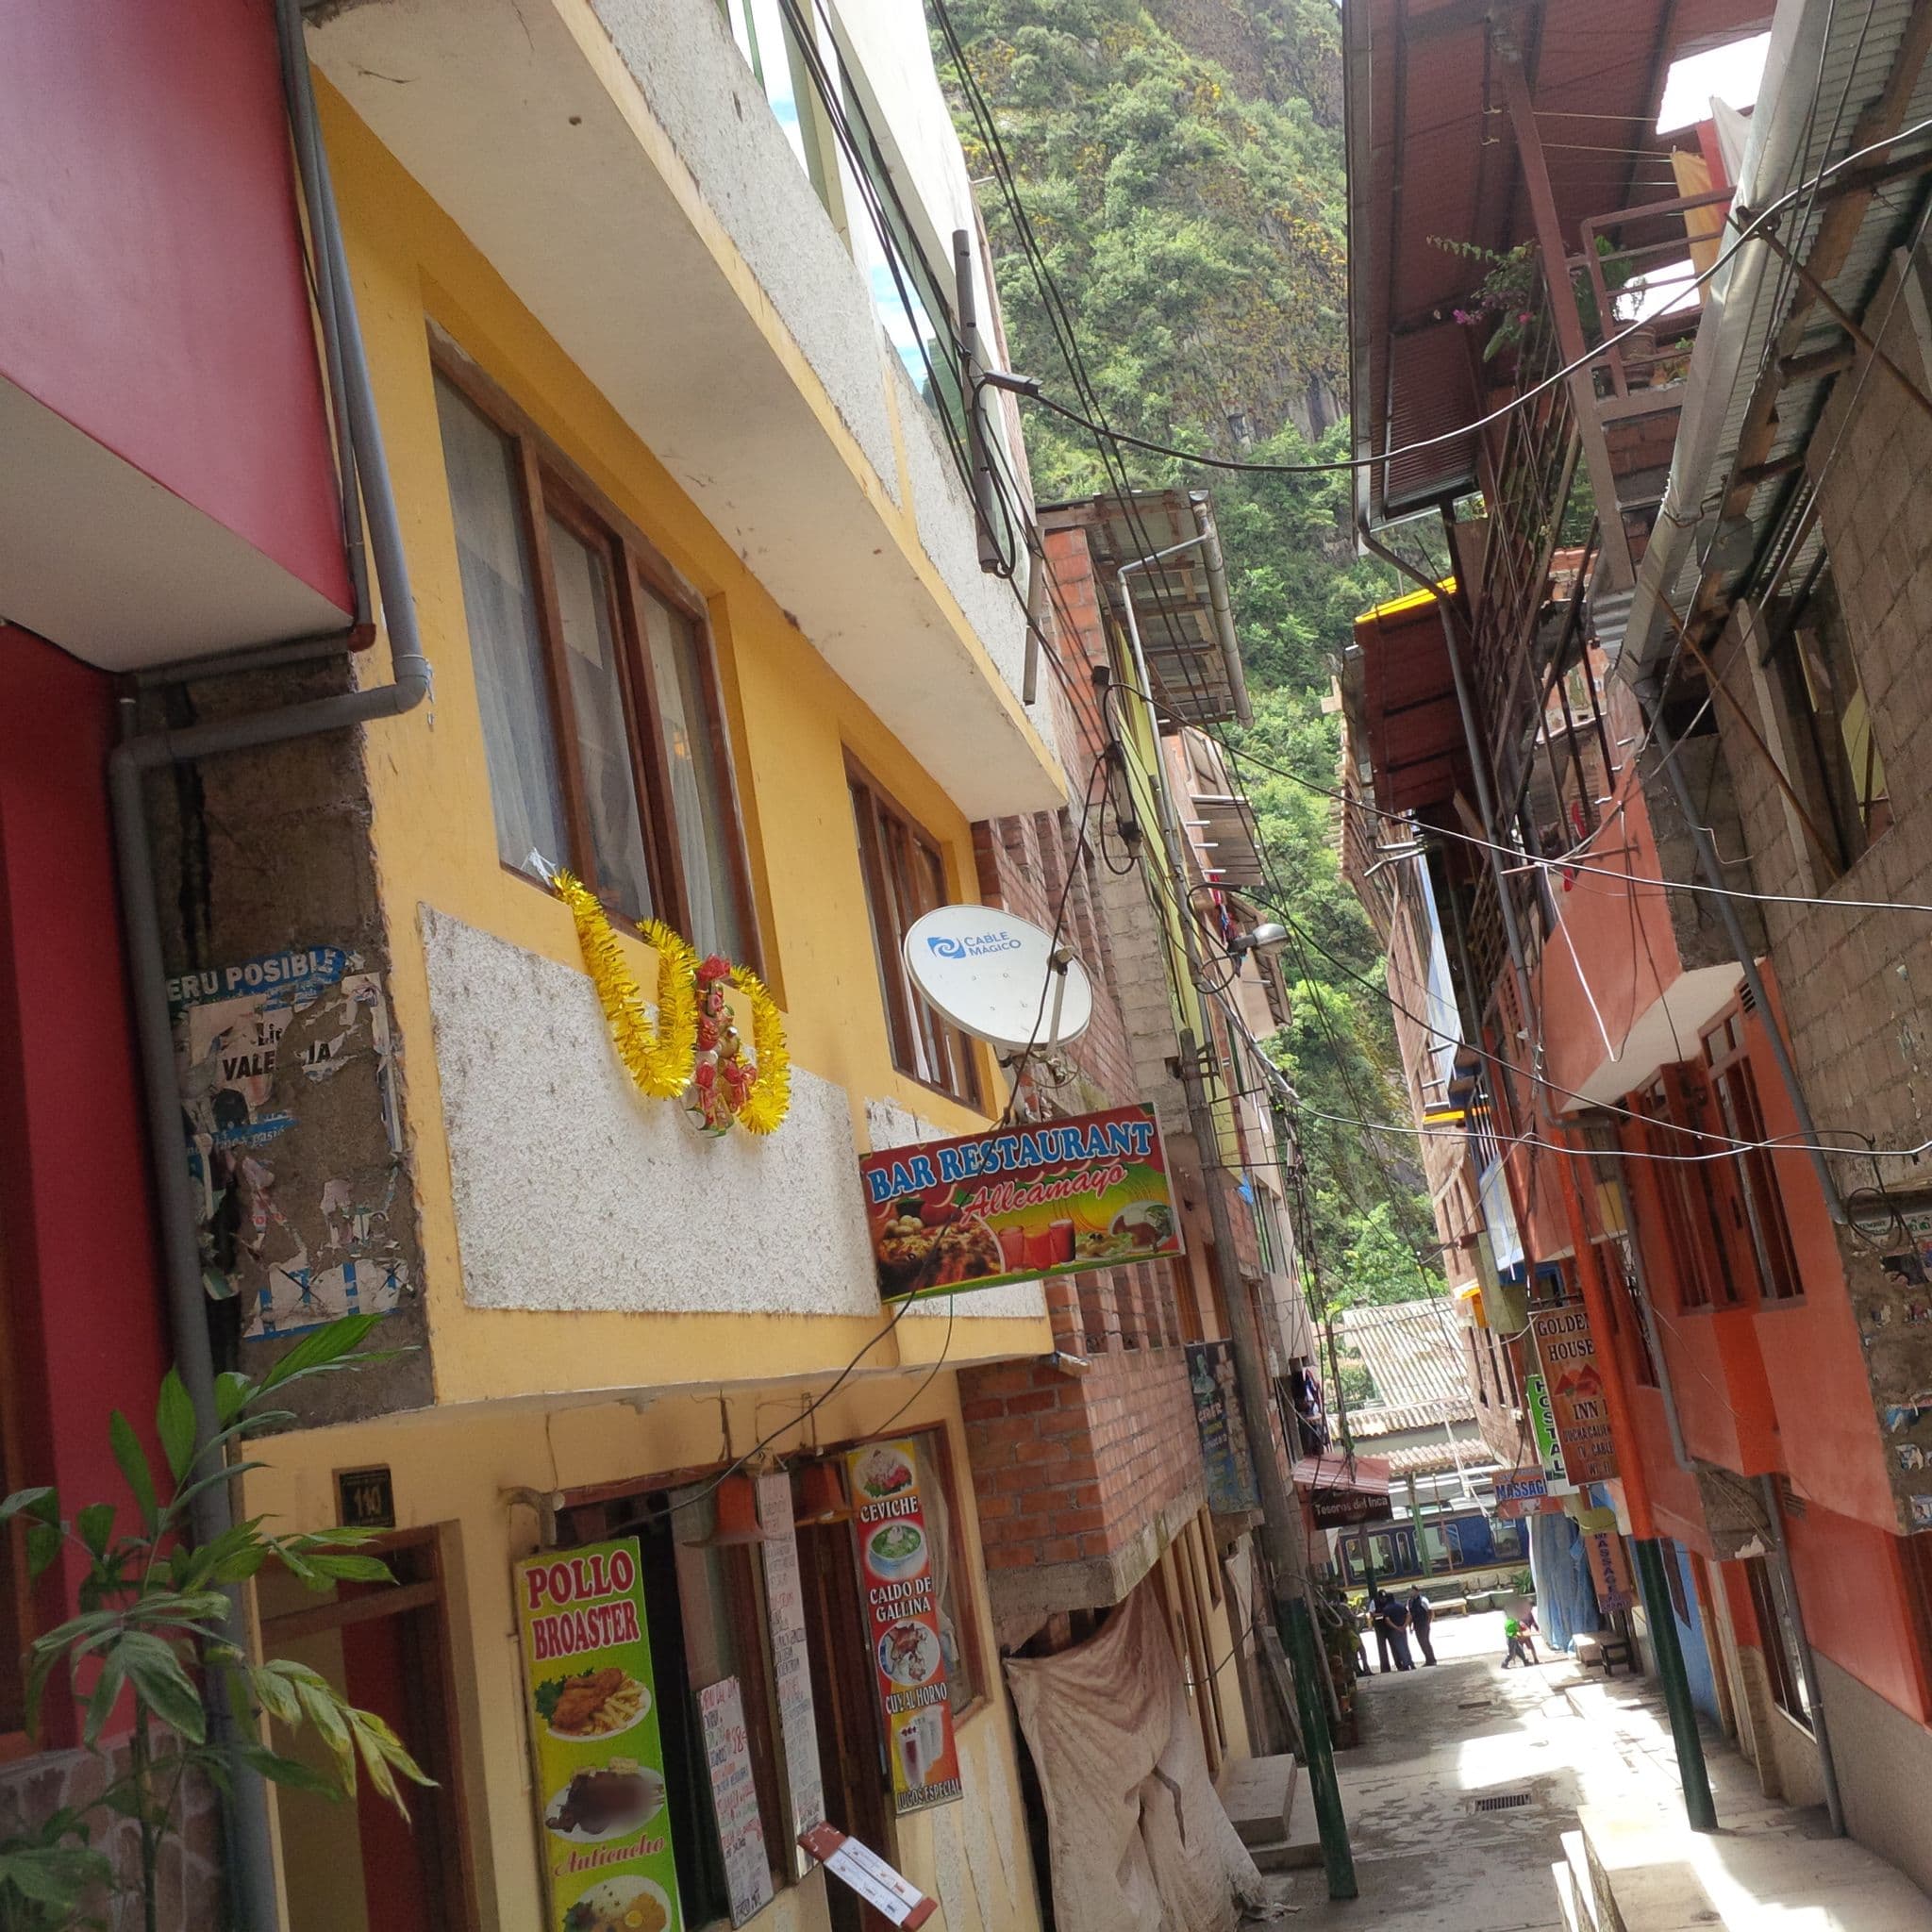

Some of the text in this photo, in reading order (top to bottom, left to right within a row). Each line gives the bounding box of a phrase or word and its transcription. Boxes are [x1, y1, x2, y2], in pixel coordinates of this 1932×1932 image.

[963, 930, 1009, 949] CABLE
[166, 971, 219, 1002] ERU
[867, 1122, 1155, 1204] BAR RESTAURANT
[959, 1163, 1128, 1227] Allcamayo
[1547, 1339, 1595, 1361] HOUSE
[1573, 1401, 1599, 1420] INN
[859, 1496, 919, 1524] CEVICHE
[1315, 1496, 1388, 1516] Tesoros del Inca
[525, 1549, 636, 1610] POLLO
[870, 1577, 932, 1606] CALDO DE
[876, 1596, 931, 1623] GALLINA
[532, 1599, 641, 1661] BROASTER
[905, 1693, 916, 1709] AL
[916, 1682, 948, 1707] HORNO
[897, 1786, 924, 1809] JUGOS
[553, 1833, 665, 1876] Anticucho
